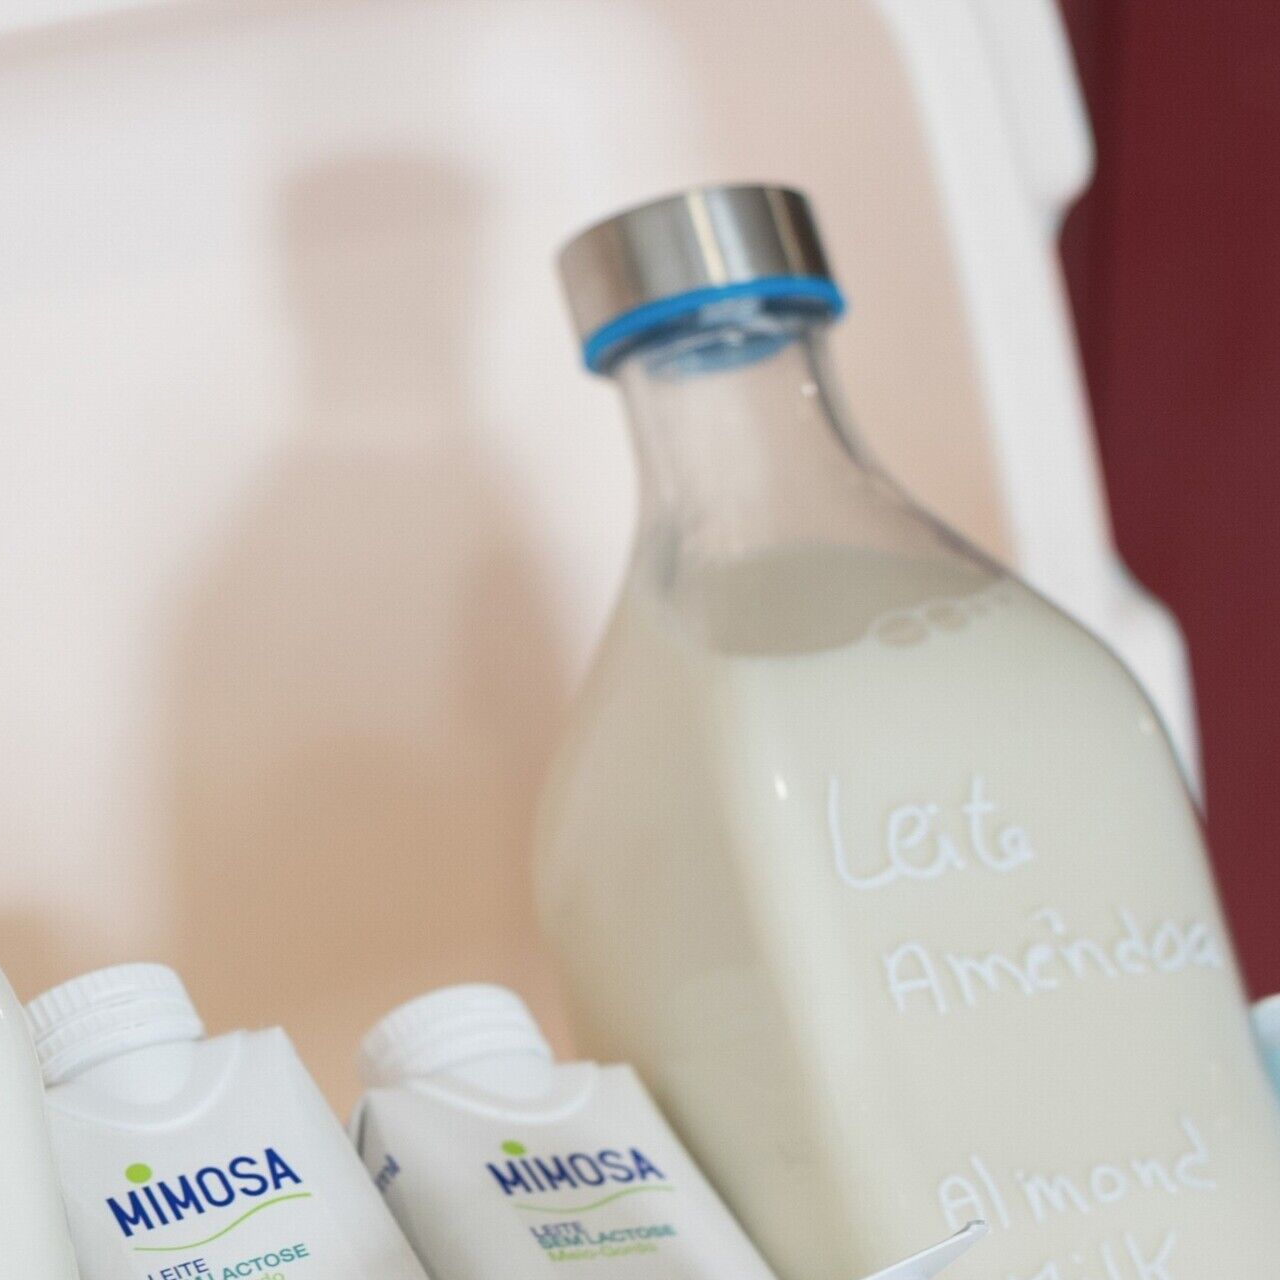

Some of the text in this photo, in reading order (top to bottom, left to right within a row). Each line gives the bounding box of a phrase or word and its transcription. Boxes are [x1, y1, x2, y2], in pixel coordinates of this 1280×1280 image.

[106, 1147, 303, 1238] MIMOSA
[487, 1147, 666, 1197] MIMOSA
[935, 1116, 1216, 1232] Almond
